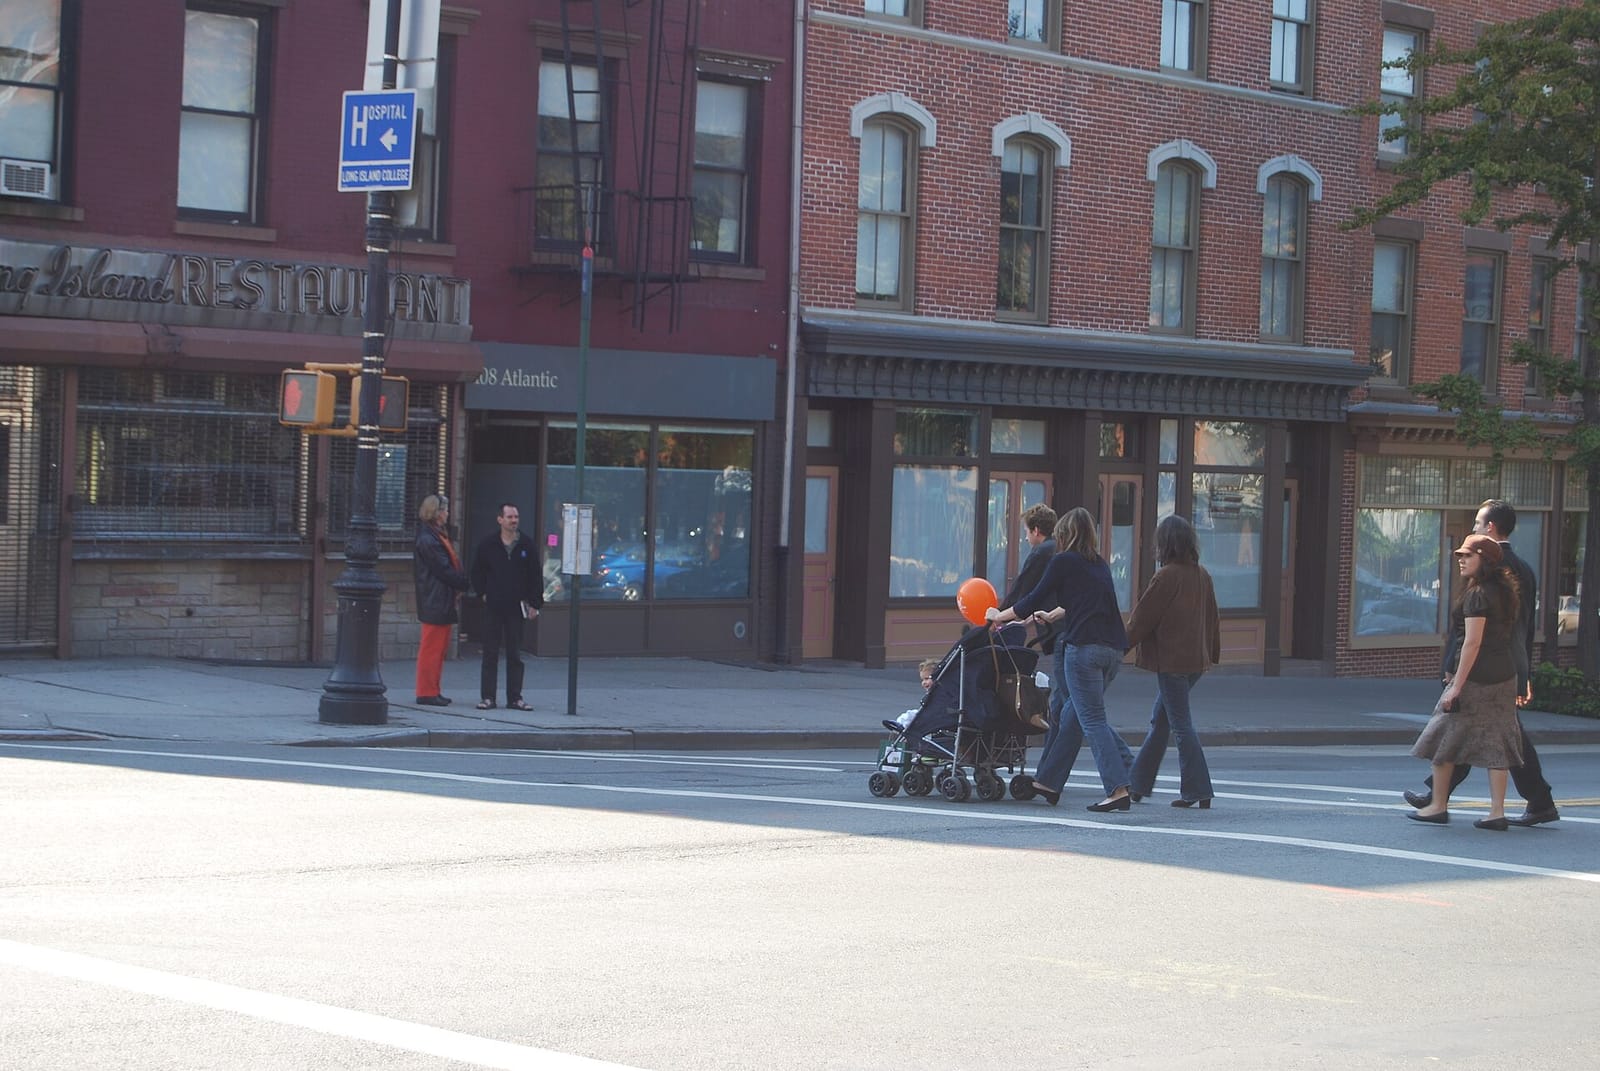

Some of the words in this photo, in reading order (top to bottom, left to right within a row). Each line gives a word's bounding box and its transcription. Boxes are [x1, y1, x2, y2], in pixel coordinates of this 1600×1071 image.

[351, 104, 407, 147] HOSPITAL
[342, 170, 359, 182] LONG
[360, 170, 381, 182] ISLAND
[382, 168, 409, 181] COLLEGE
[40, 245, 175, 303] Island
[475, 367, 497, 385] 08
[501, 368, 559, 388] Atlantic
